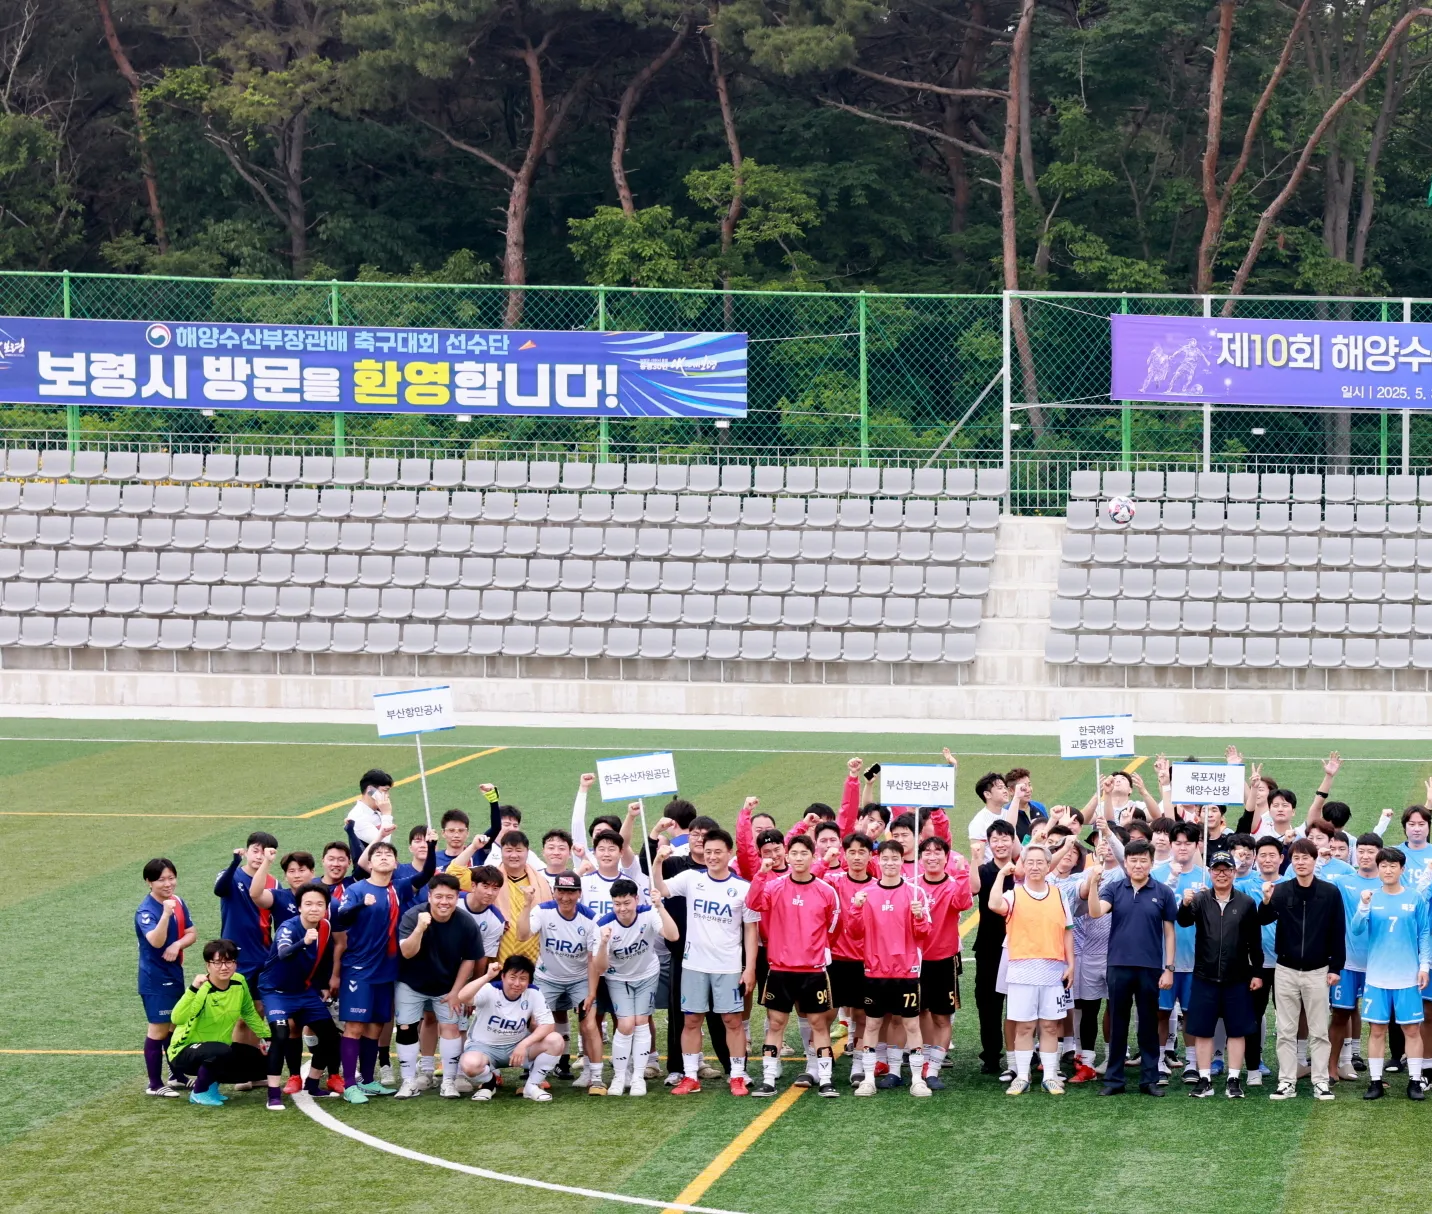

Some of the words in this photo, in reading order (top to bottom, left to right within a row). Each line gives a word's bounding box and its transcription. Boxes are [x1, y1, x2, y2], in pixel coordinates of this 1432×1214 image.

[175, 326, 348, 352] 해양수산부장관배
[354, 331, 439, 354] 축구대회
[446, 334, 510, 355] 선수단
[1217, 332, 1321, 370] 제10회
[38, 351, 187, 400] 보령시
[203, 356, 340, 402] 방문을
[354, 359, 619, 408] 환영합니다!
[1341, 386, 1365, 398] 일시
[1377, 386, 1410, 399] 2025.
[1415, 387, 1427, 400] 5.
[387, 704, 443, 720] 부산항만공사
[1079, 725, 1114, 736] 한국해양
[1071, 738, 1123, 749] 교통안전공단
[604, 768, 670, 785] 한국수산자원공단
[1190, 772, 1226, 783] 목포지방
[886, 780, 949, 791] 부산항보안공사
[1186, 784, 1230, 796] 해양수산청
[589, 901, 613, 915] FIR
[694, 899, 732, 918] FIRA
[792, 898, 804, 907] BPS
[881, 904, 894, 912] BPS
[1388, 916, 1398, 932] 7
[545, 938, 583, 953] FIRA
[613, 939, 649, 957] FIRA
[903, 993, 917, 1008] 72
[1334, 985, 1342, 1001] 6
[1363, 998, 1373, 1015] 7
[488, 1015, 526, 1031] FIRA
